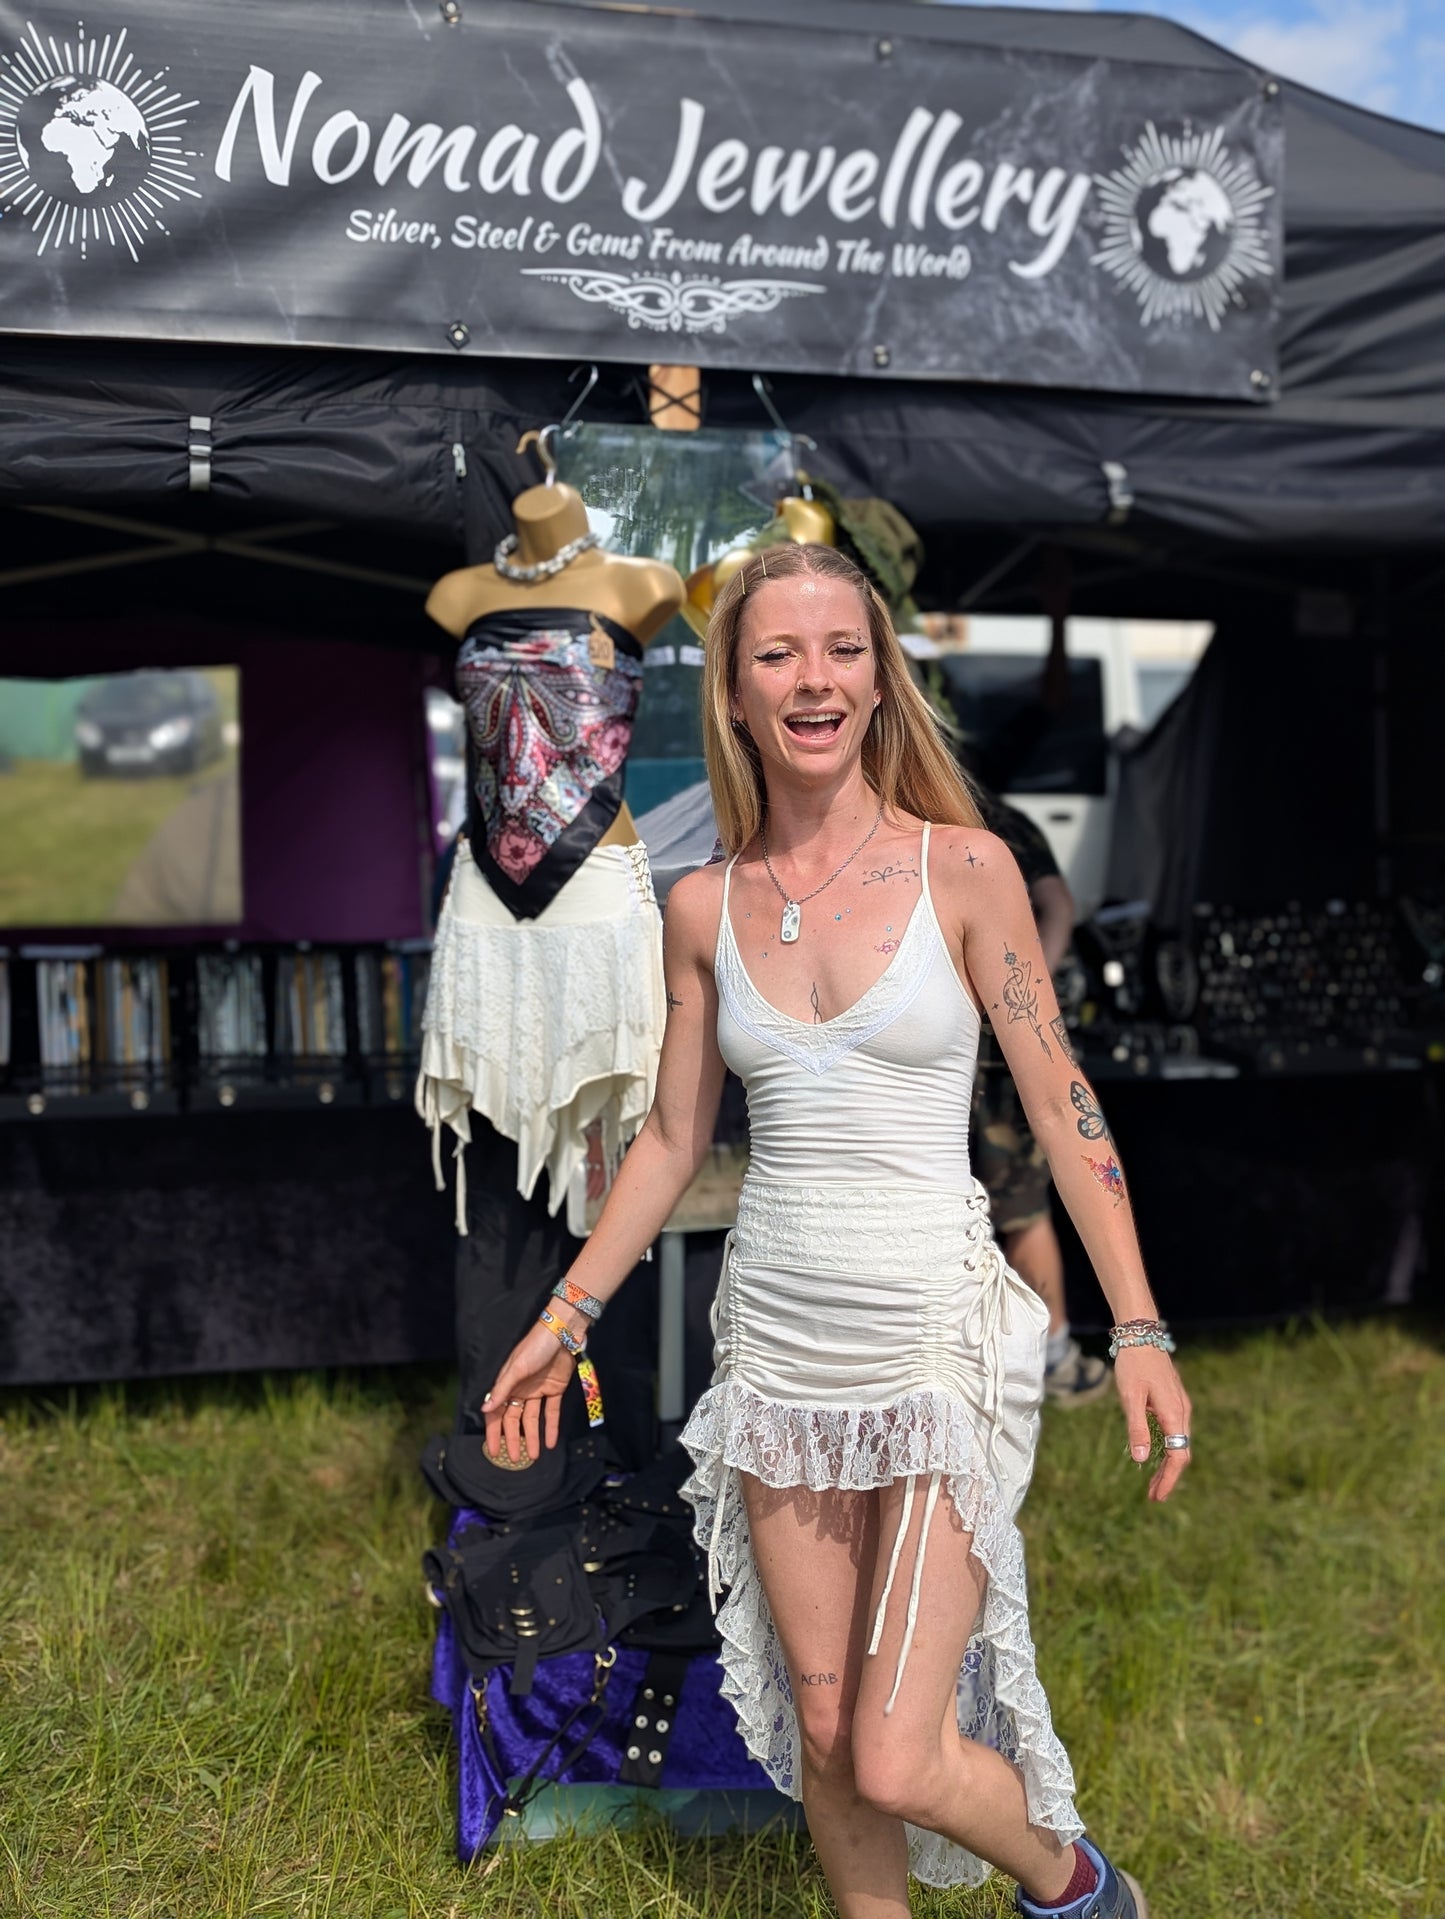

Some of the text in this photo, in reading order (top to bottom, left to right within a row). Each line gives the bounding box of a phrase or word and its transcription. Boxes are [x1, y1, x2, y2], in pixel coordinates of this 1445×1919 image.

[215, 65, 1091, 279] Nomad Jewellery
[346, 208, 971, 280] Silver, Steel & Gems From Around The World
[801, 1672, 838, 1687] ACAB
